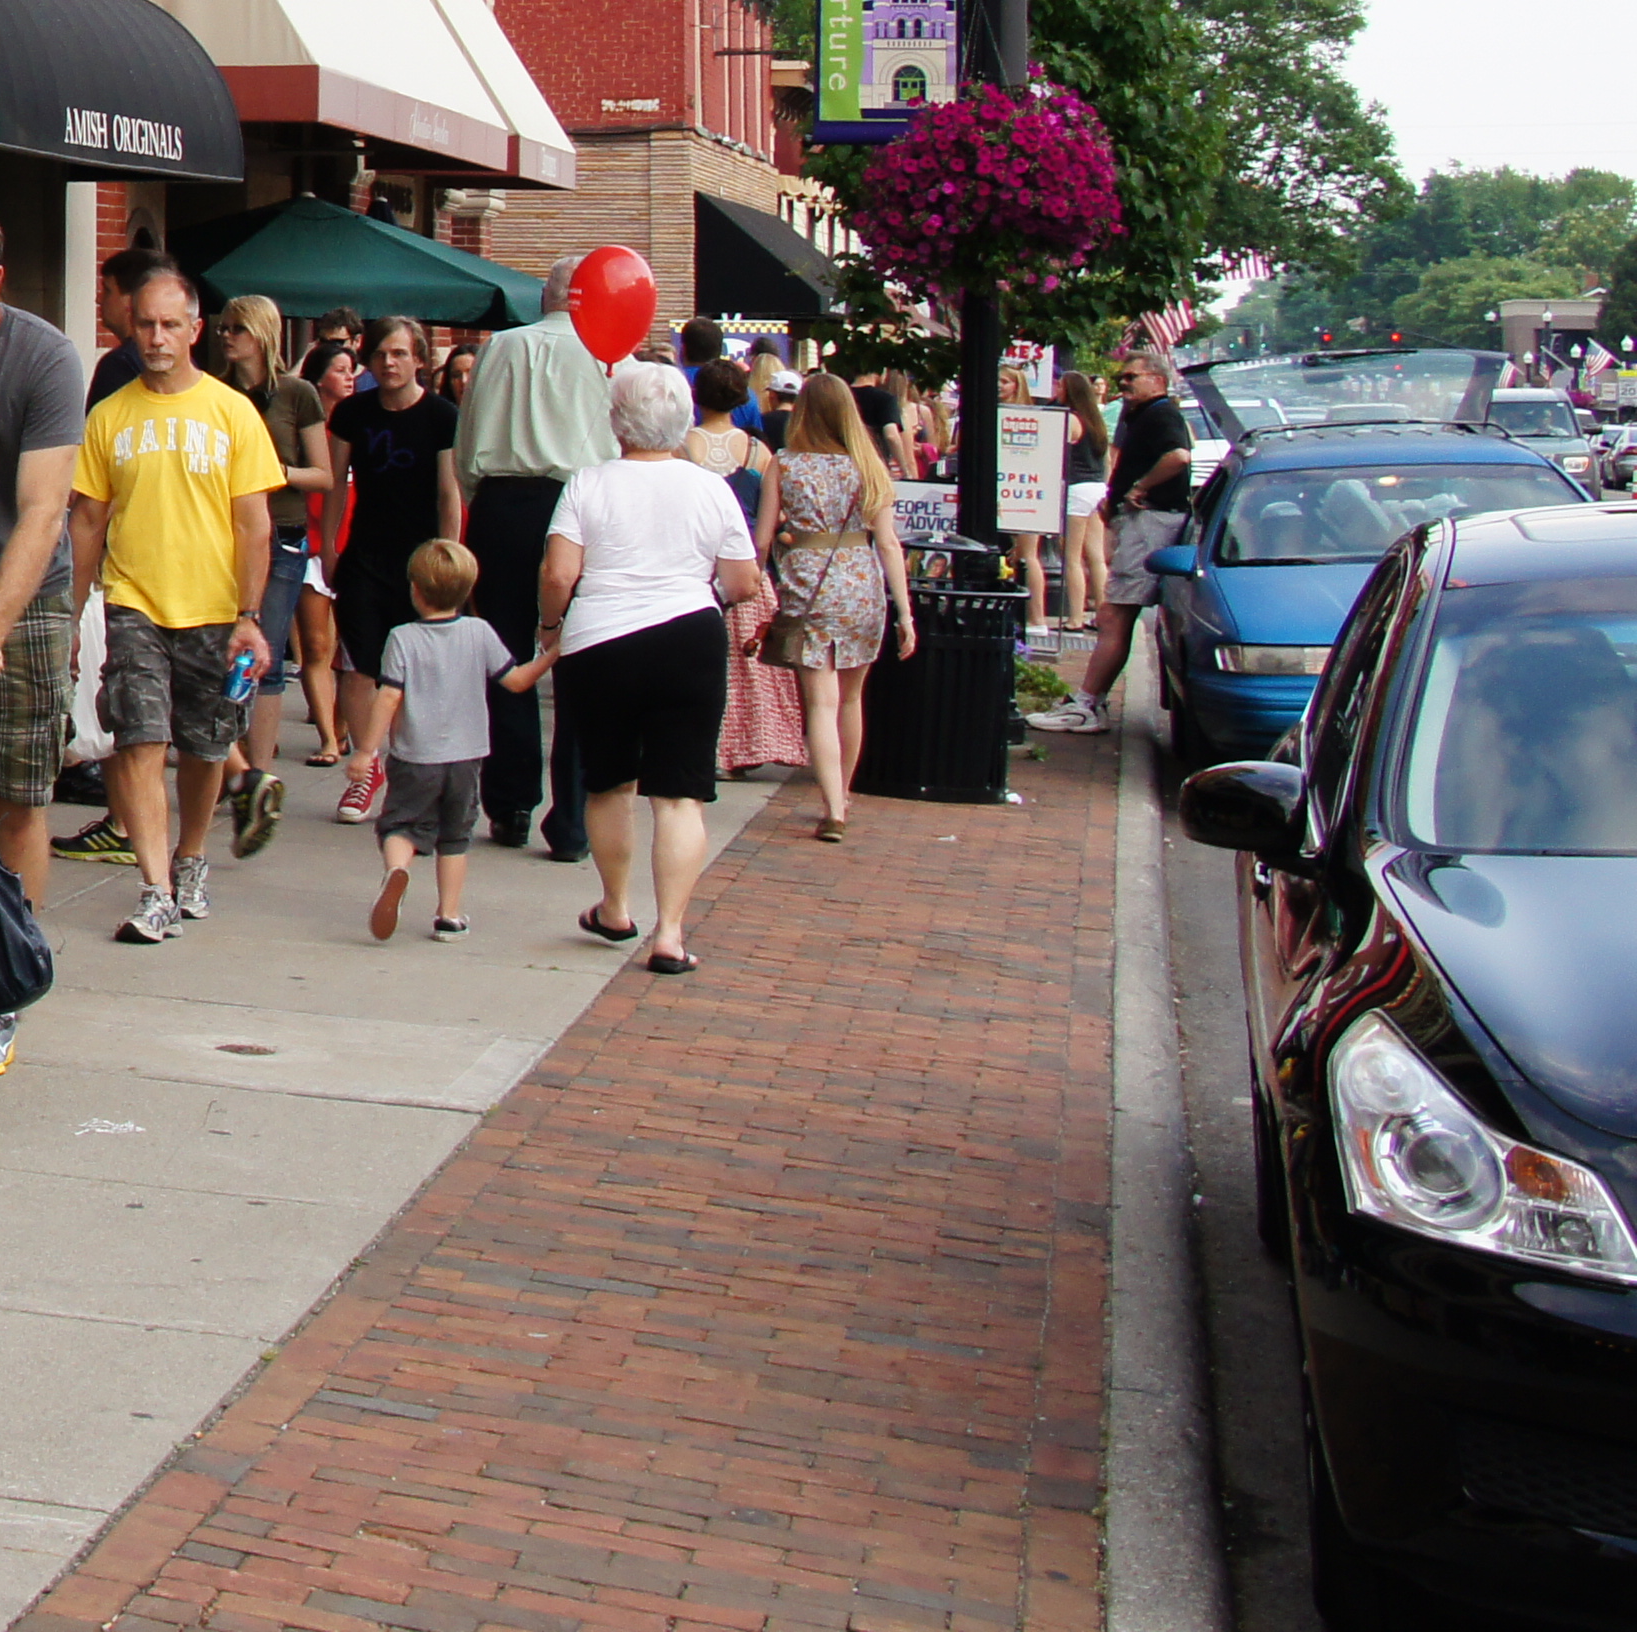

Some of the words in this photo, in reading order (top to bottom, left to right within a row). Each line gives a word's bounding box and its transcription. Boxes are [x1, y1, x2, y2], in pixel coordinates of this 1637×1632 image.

[64, 106, 108, 149] AMISH
[112, 113, 183, 161] ORIGINALS
[114, 417, 230, 467] MAINE
[1000, 489, 1044, 500] OUSE
